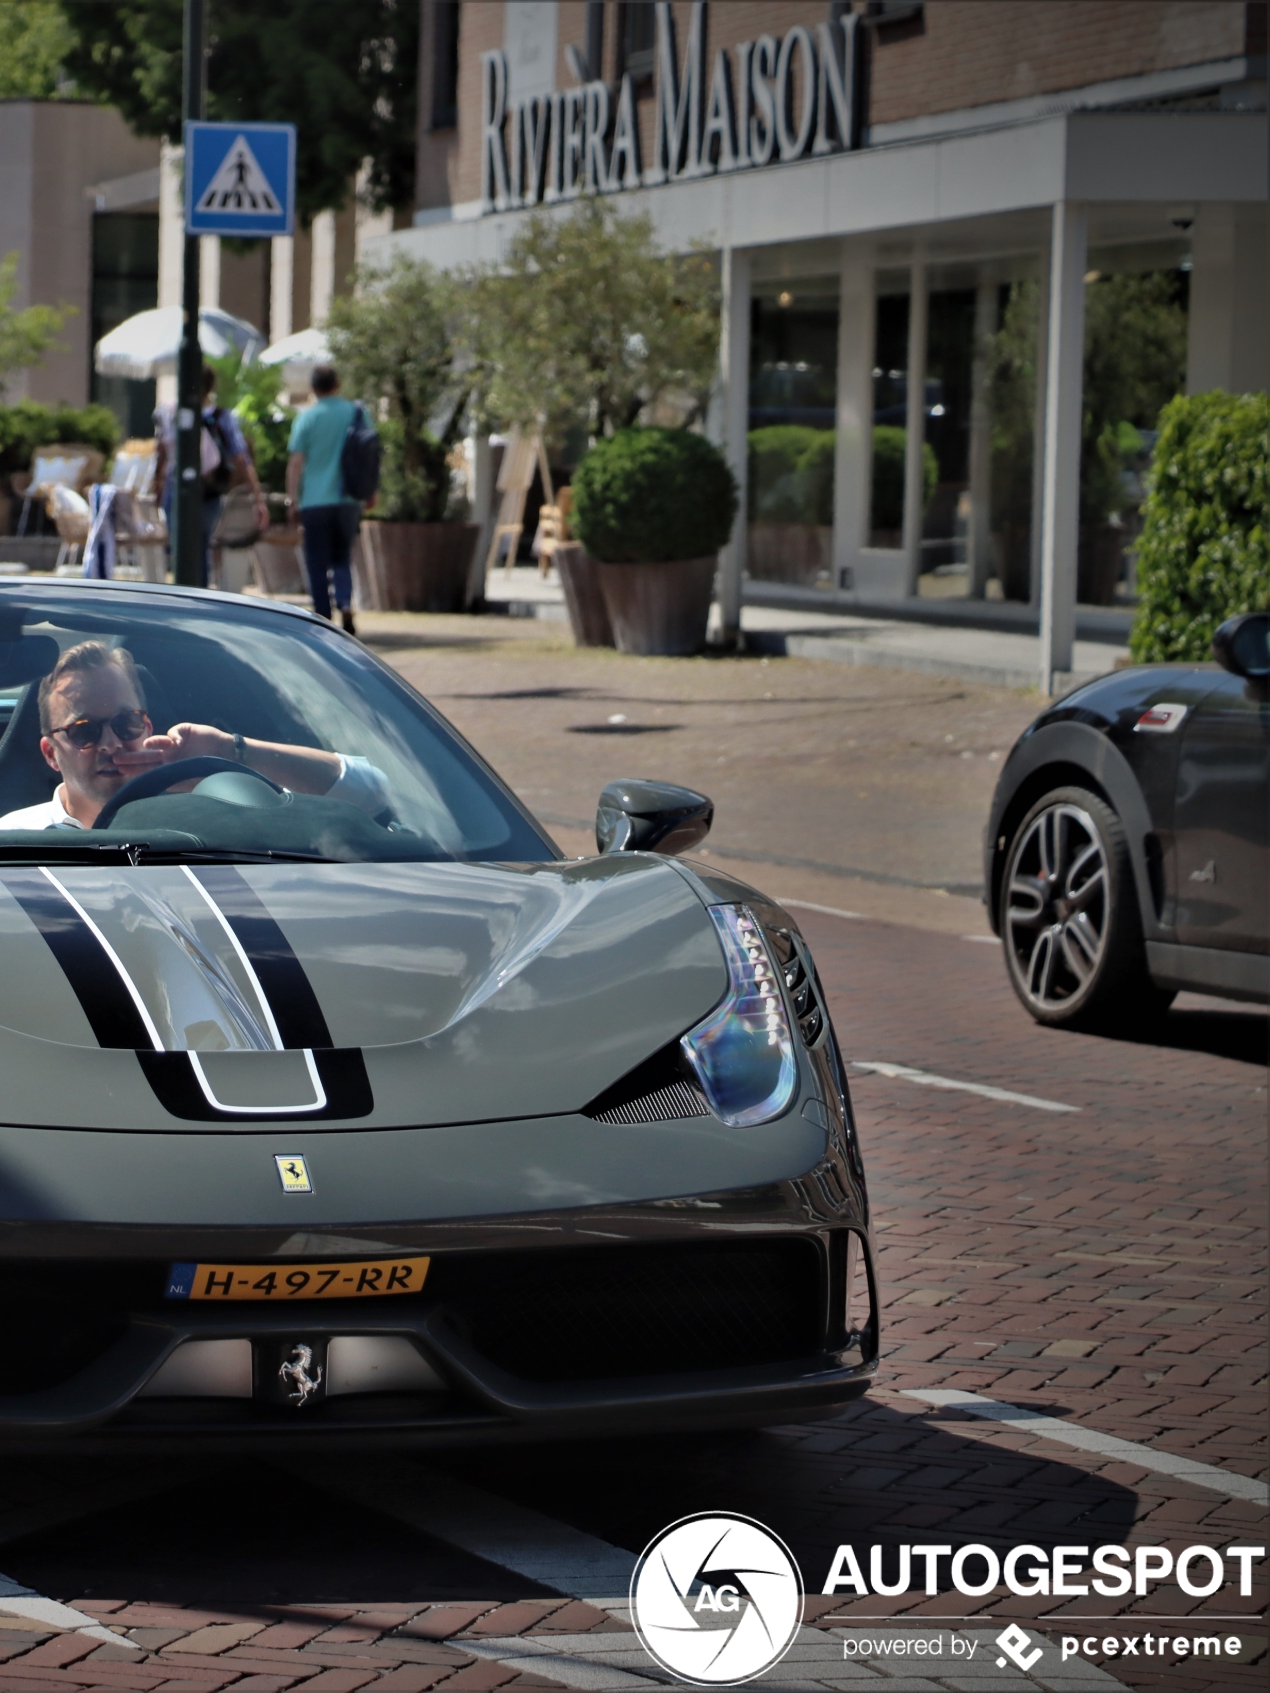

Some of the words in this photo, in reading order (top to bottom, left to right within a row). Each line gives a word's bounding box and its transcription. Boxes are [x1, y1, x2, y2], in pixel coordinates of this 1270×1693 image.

[641, 2, 860, 185] MAISON
[170, 1285, 187, 1294] NL
[204, 1265, 413, 1296] H-497-RR
